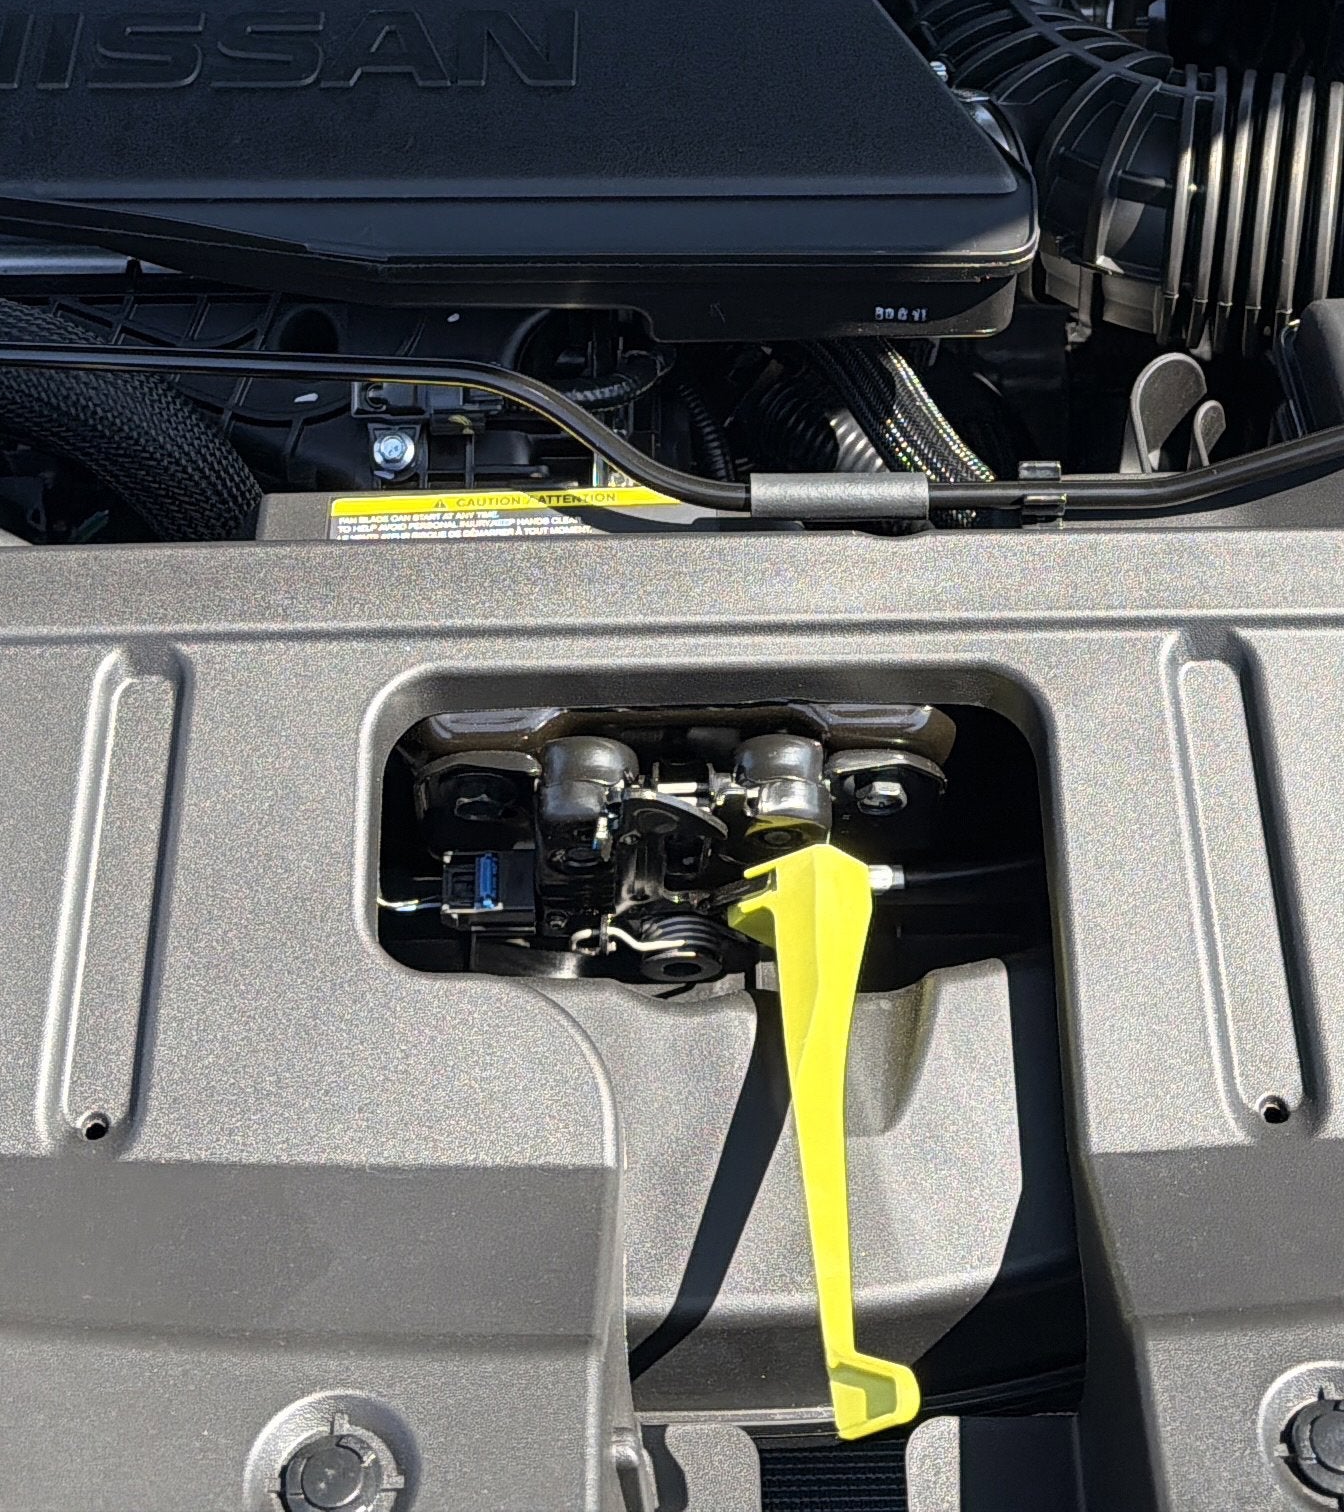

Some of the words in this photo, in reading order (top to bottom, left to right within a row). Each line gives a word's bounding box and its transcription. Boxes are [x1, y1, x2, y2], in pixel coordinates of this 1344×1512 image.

[456, 496, 521, 508] CAUTION
[538, 492, 617, 505] ATTENTION
[517, 517, 549, 526] HANDS
[523, 526, 549, 535] TOUT
